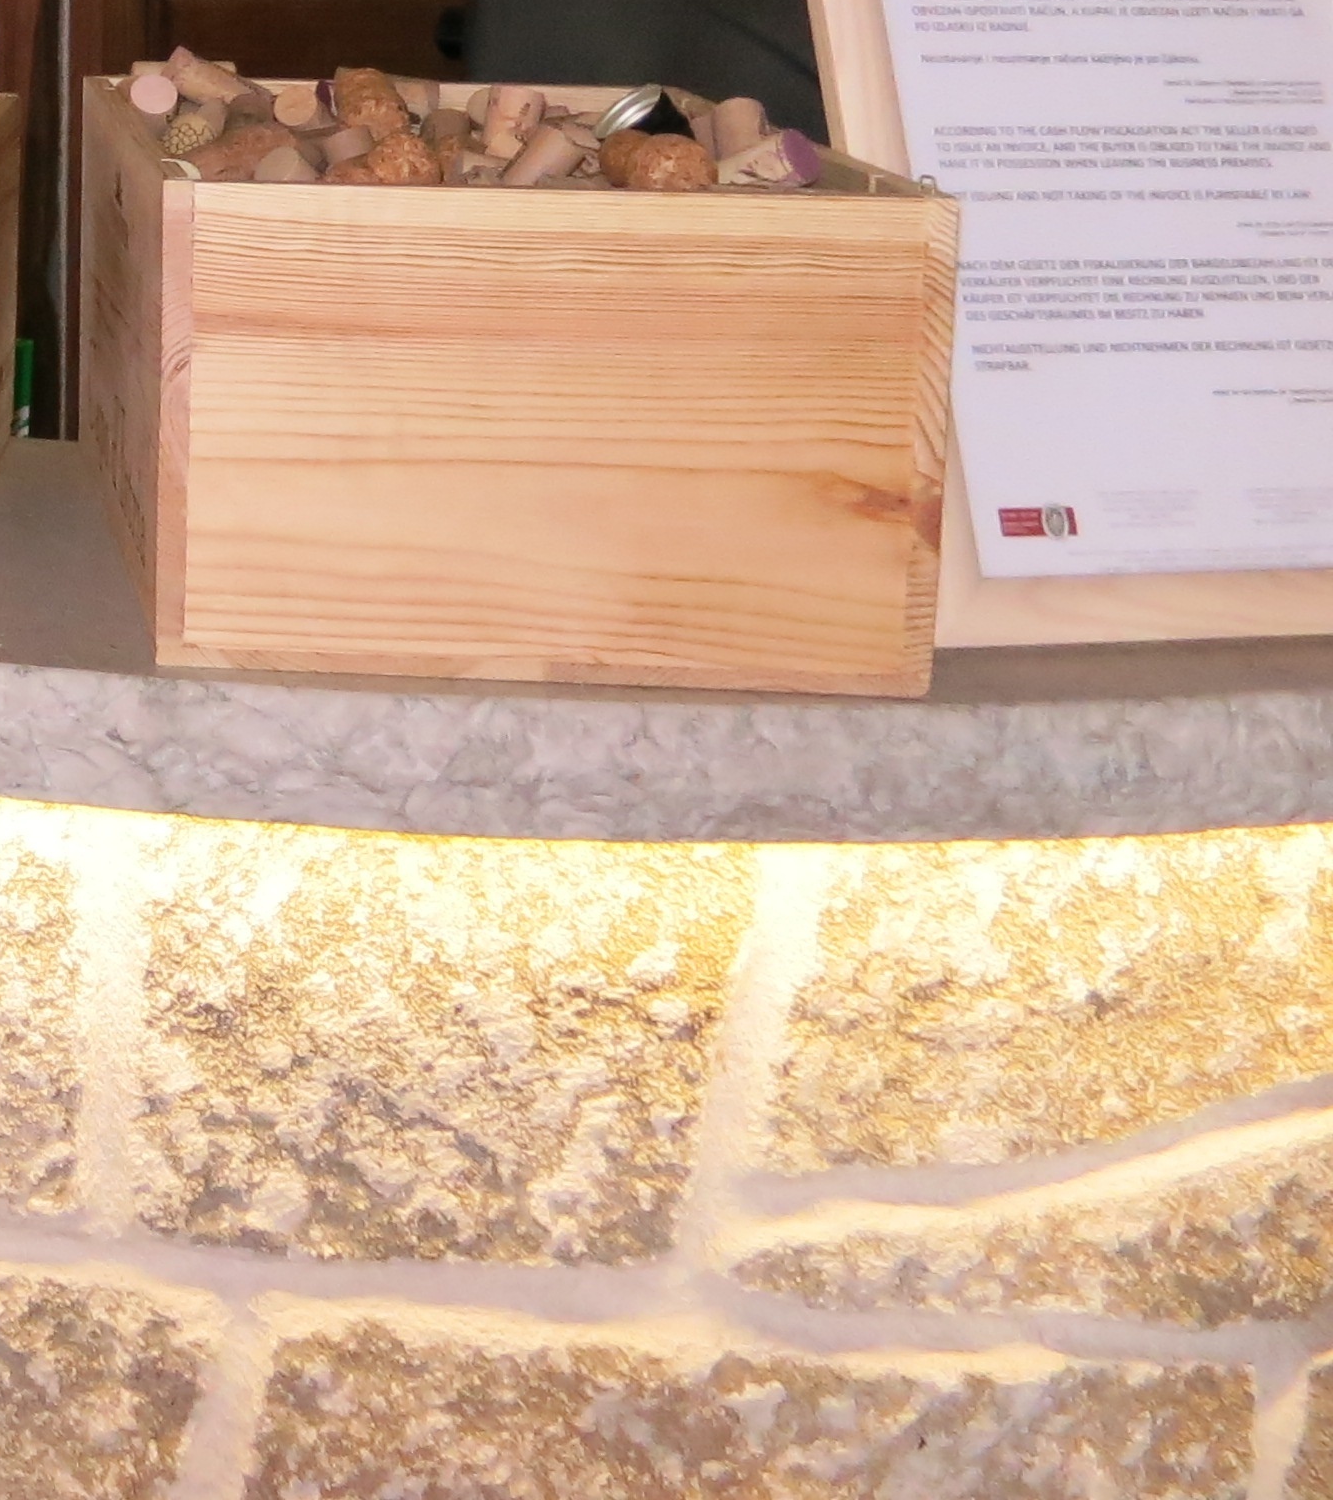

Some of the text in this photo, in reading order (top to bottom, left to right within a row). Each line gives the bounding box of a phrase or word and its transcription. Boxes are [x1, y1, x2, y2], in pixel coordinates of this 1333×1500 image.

[1017, 126, 1036, 136] THE
[1039, 126, 1067, 136] CASH
[1069, 126, 1101, 136] FLOW
[1053, 141, 1076, 152] AND
[1079, 141, 1099, 152] THE
